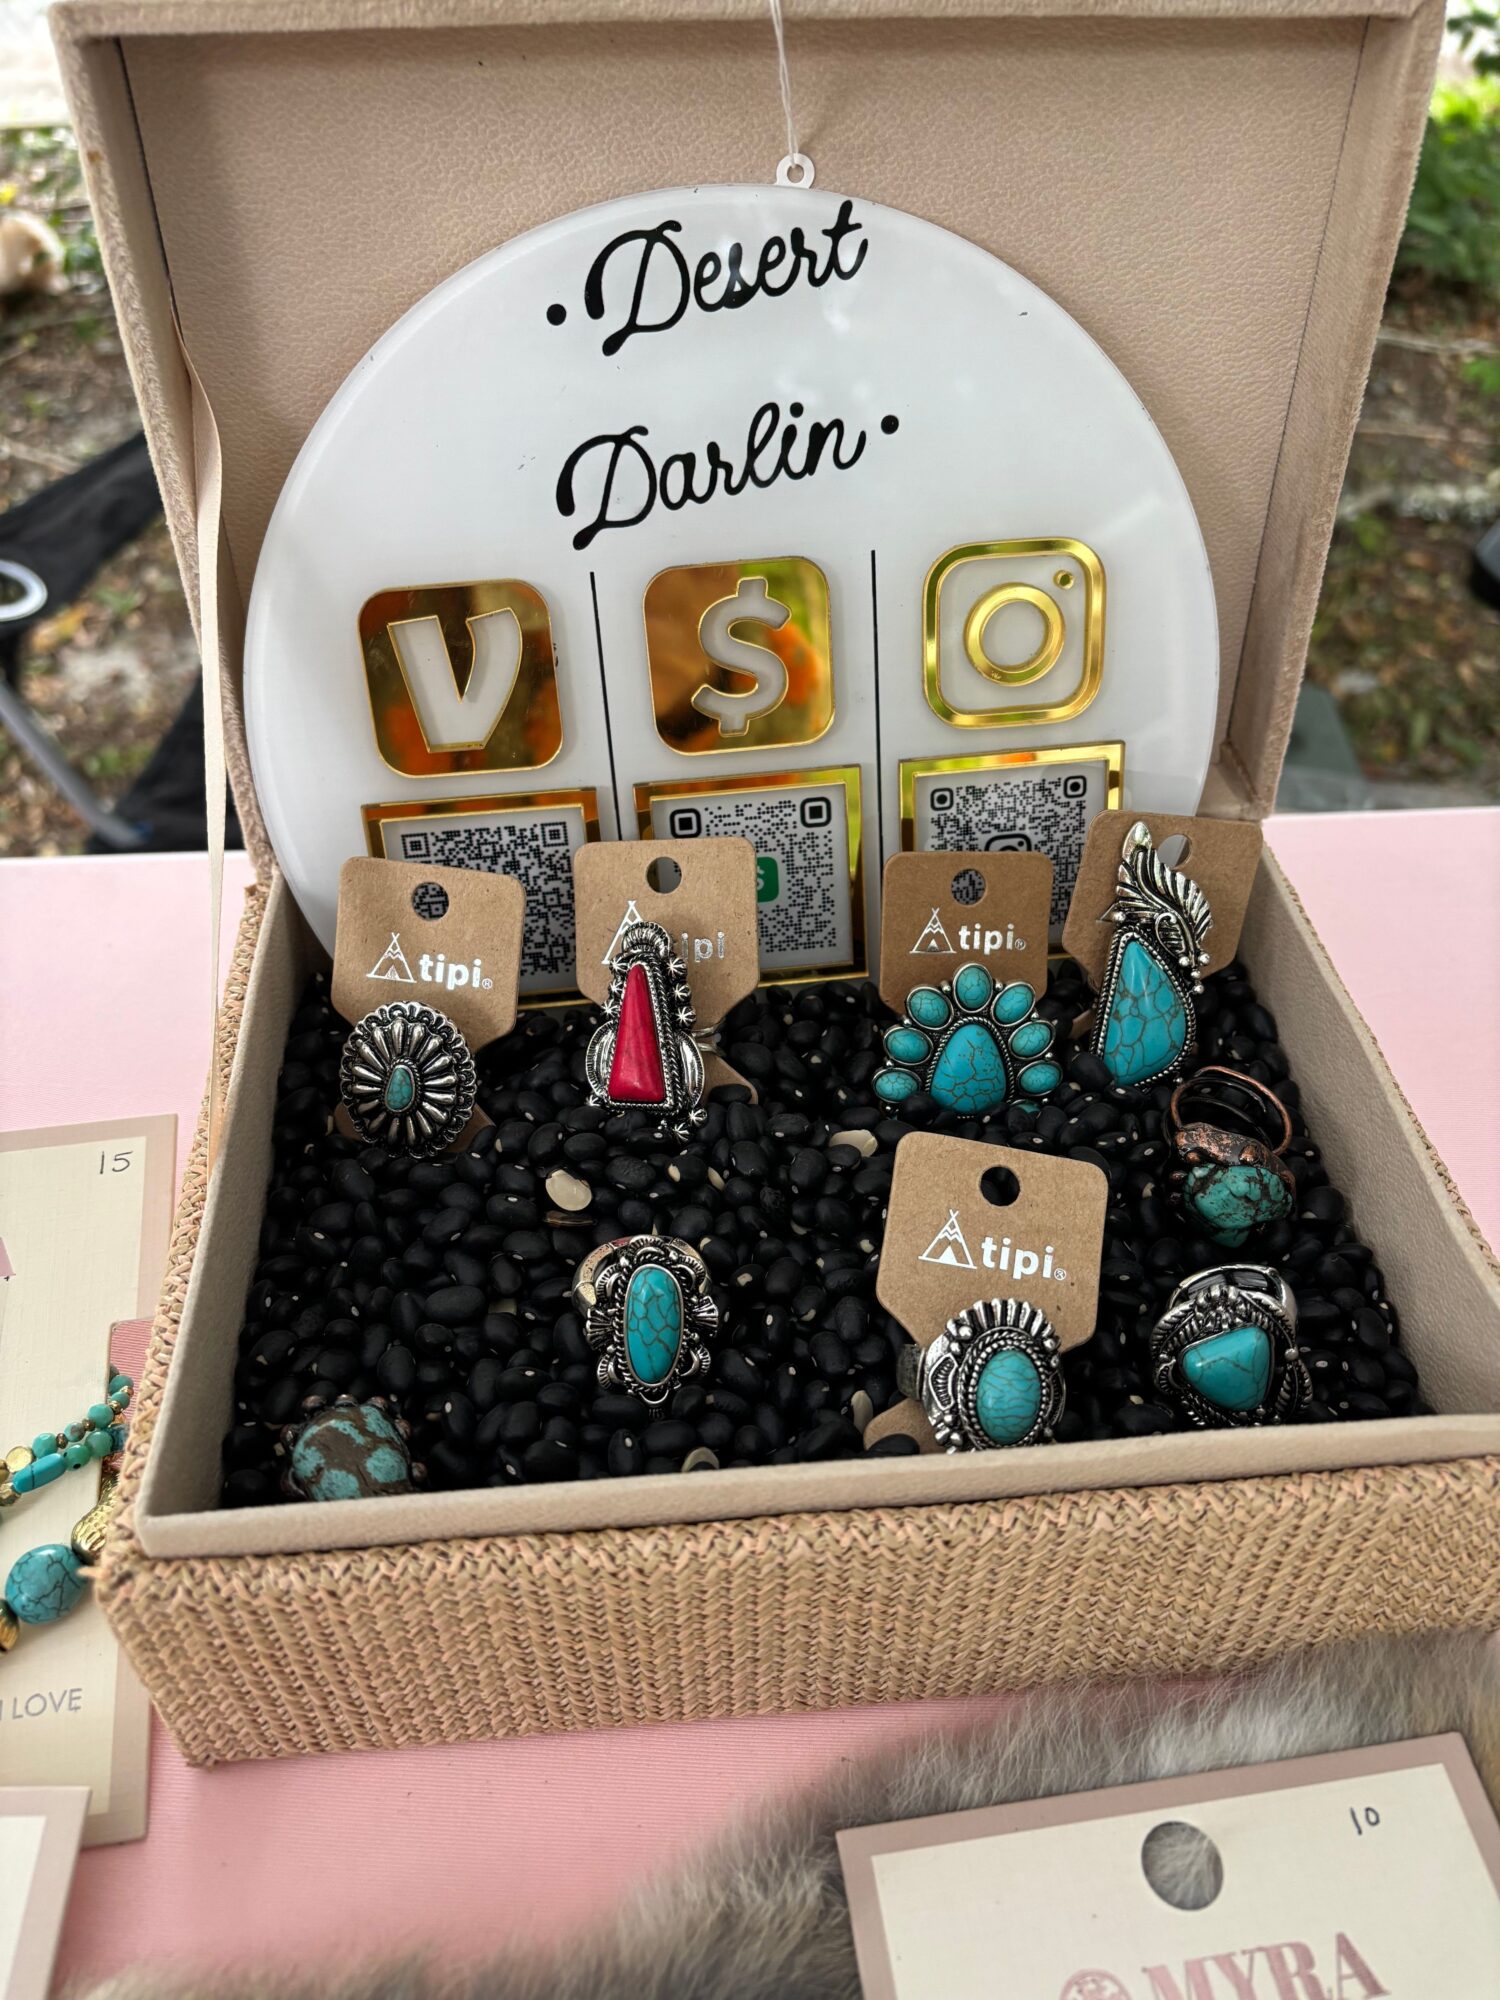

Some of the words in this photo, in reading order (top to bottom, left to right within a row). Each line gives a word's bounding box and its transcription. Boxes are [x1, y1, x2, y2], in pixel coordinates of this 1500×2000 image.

[584, 199, 869, 357] Desert
[680, 931, 725, 963] ipi
[99, 1150, 133, 1175] 15
[12, 1687, 83, 1719] LOVE
[1350, 1806, 1380, 1835] 10
[1141, 1931, 1391, 2000] MYRA
